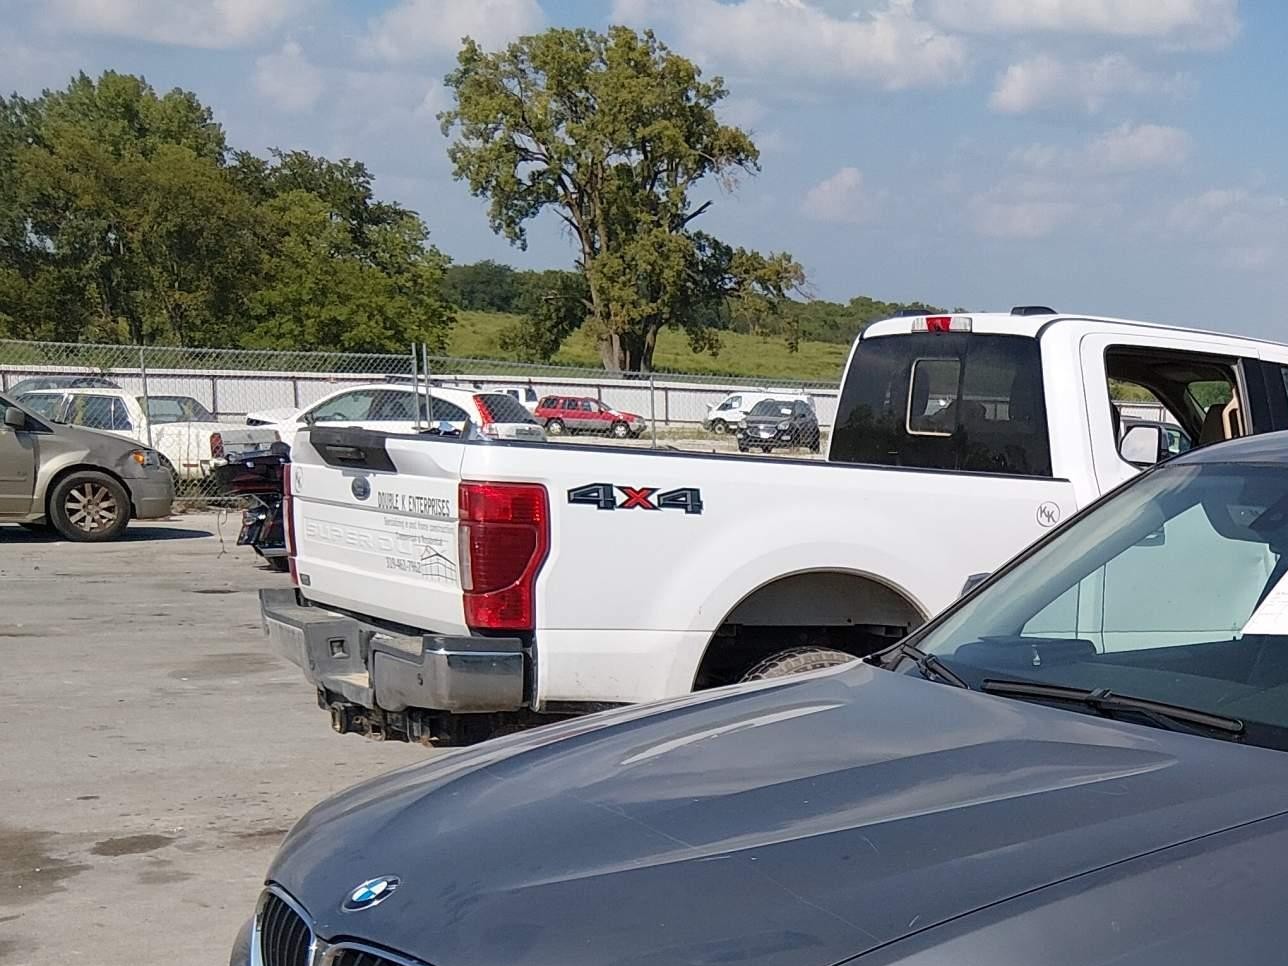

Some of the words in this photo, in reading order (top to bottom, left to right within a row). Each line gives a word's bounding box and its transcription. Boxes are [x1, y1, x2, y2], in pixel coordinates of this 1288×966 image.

[378, 491, 399, 509] DOUBLE
[401, 494, 407, 512] K
[408, 495, 450, 517] ENTERPRISES
[305, 523, 374, 549] SUPER
